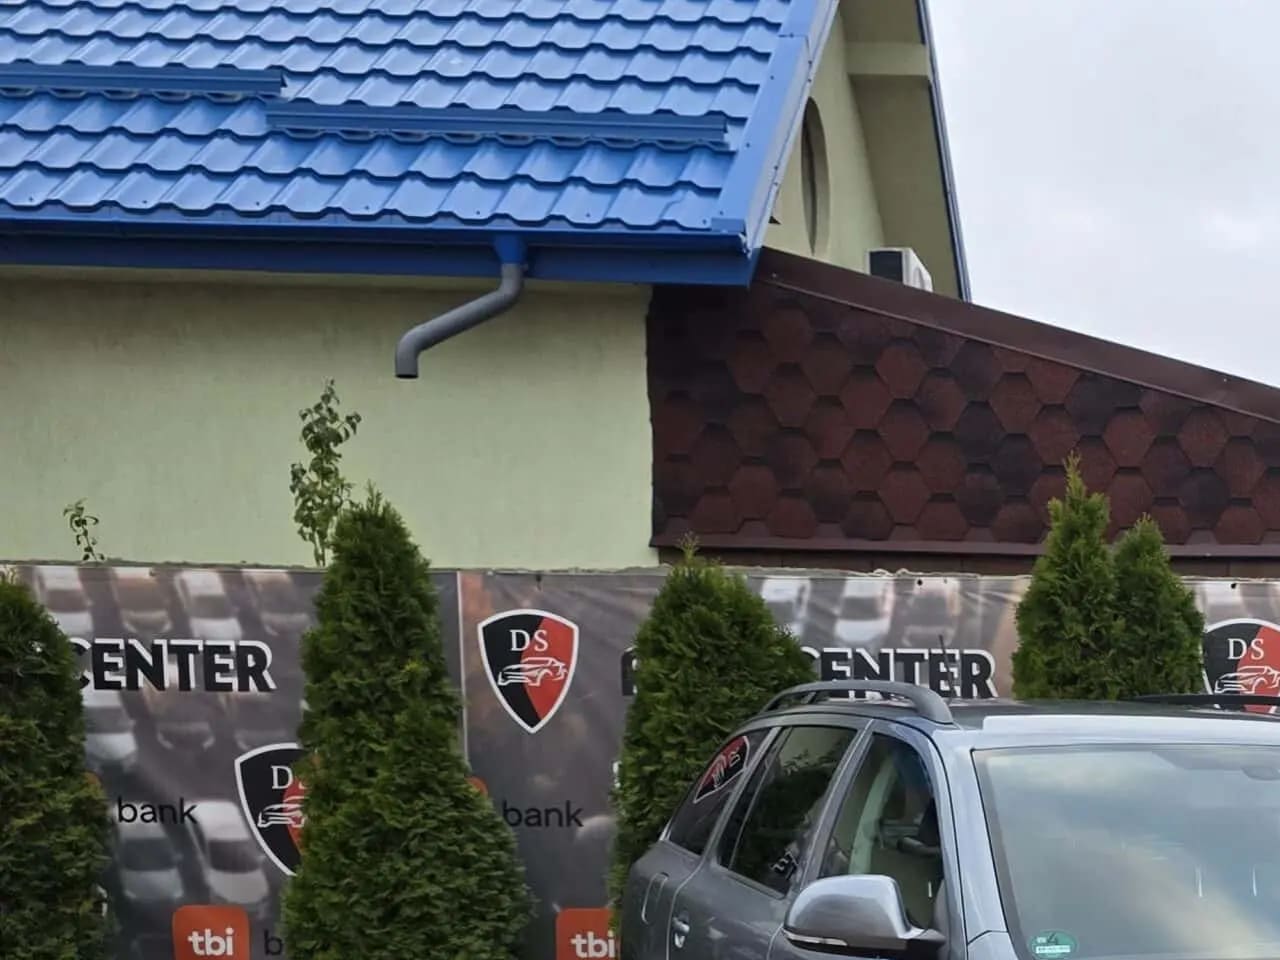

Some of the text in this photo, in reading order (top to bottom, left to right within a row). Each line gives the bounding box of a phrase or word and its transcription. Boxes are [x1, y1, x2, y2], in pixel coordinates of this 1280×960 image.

[509, 629, 549, 651] DS
[1227, 638, 1265, 660] DS
[801, 646, 999, 699] ENTER
[117, 796, 198, 824] bank
[503, 800, 584, 828] bank
[187, 927, 234, 956] tbi
[571, 930, 615, 958] tbi
